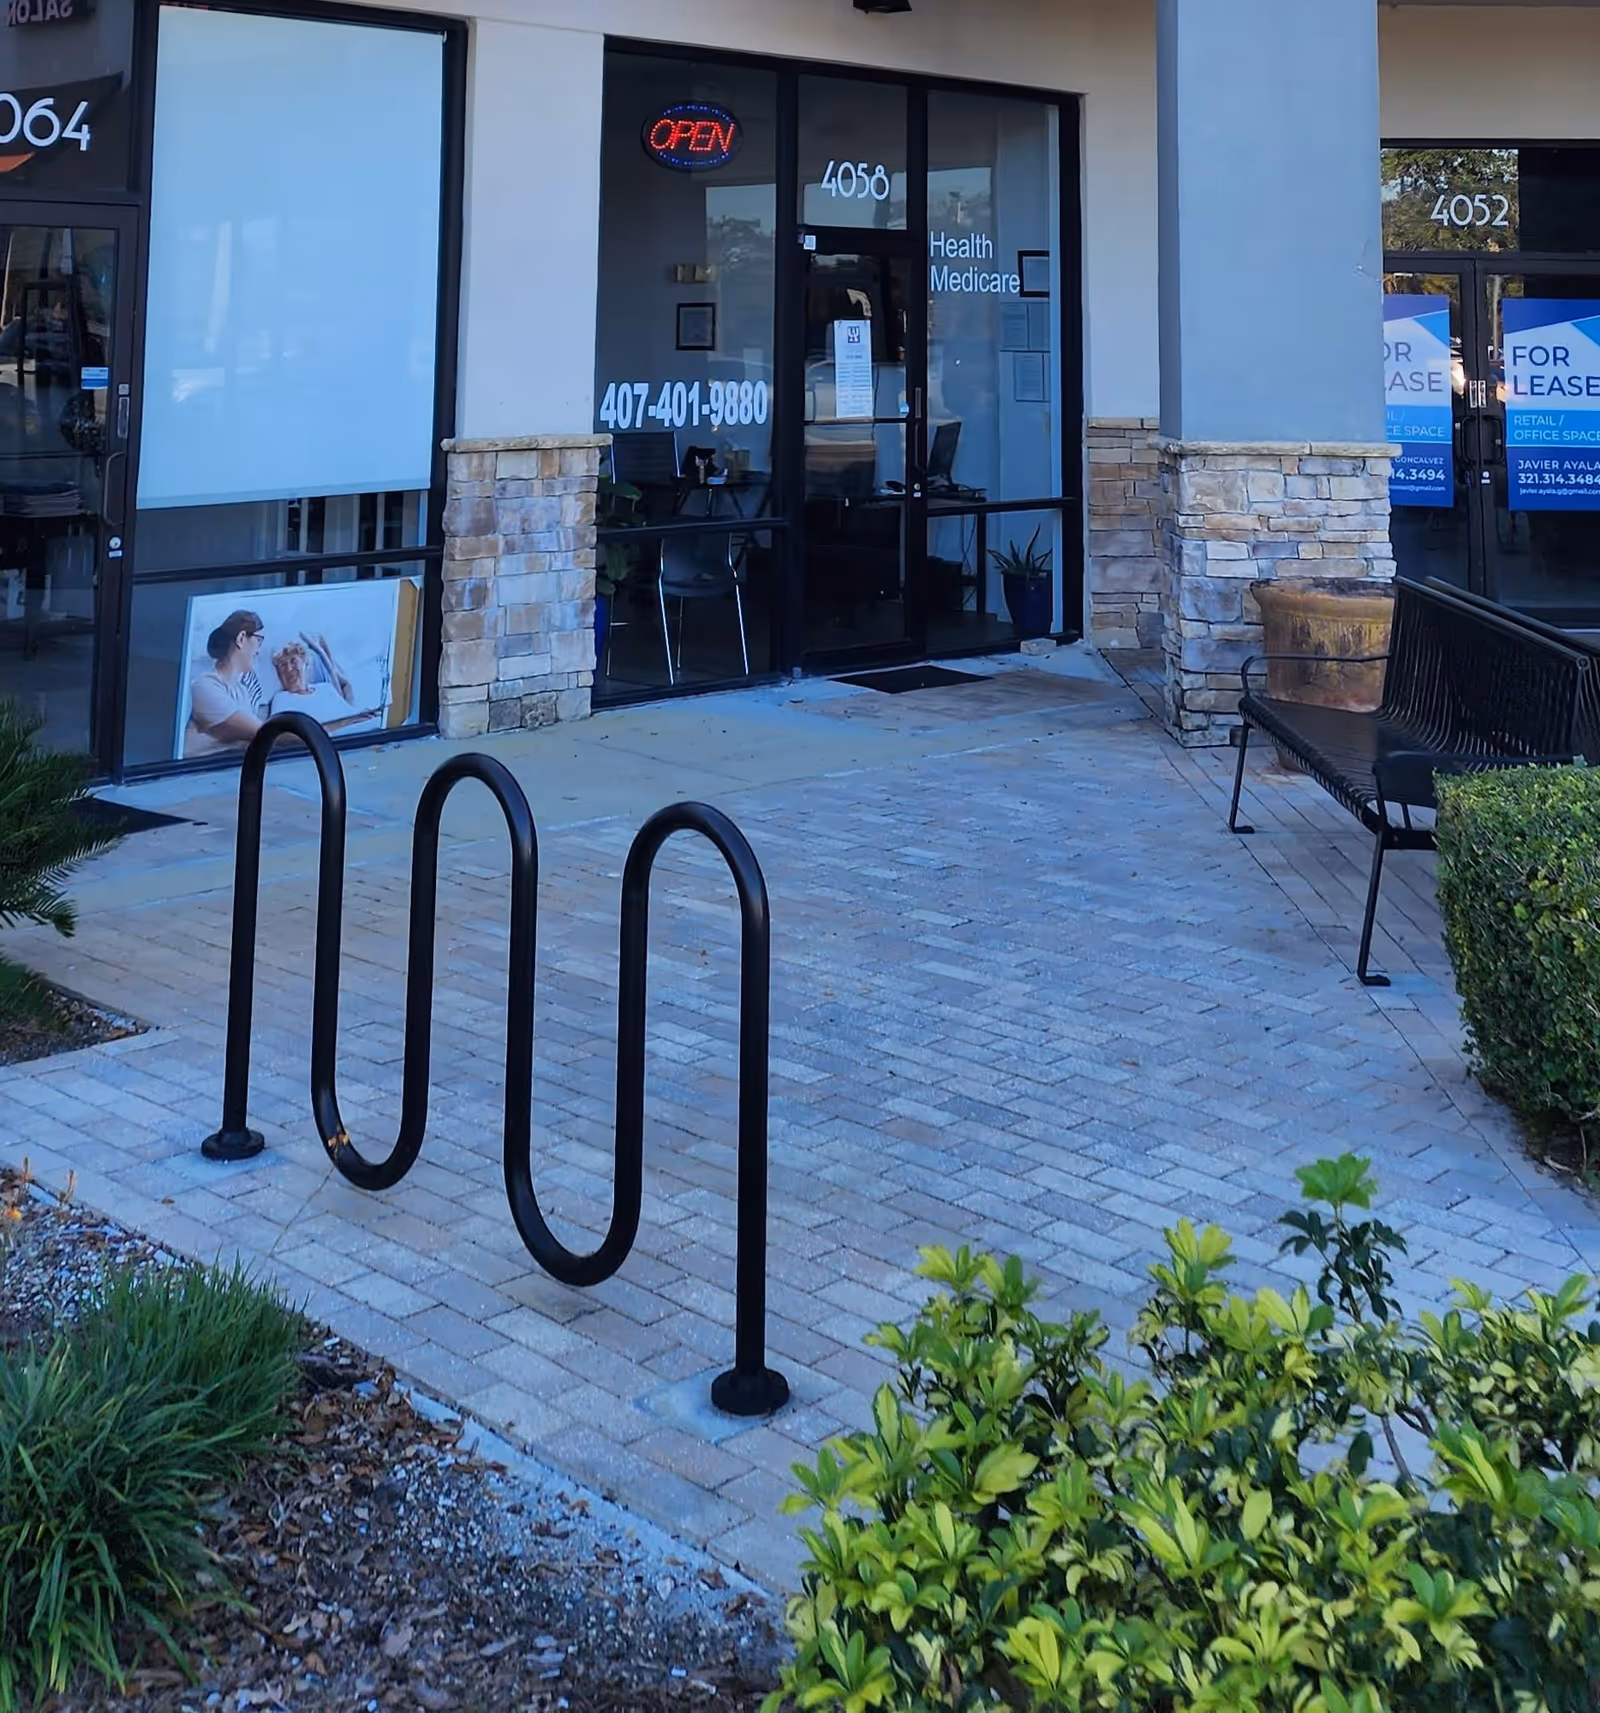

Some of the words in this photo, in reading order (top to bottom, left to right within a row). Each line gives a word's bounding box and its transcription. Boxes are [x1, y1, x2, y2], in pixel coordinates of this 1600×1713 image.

[649, 118, 736, 153] OPEN
[821, 160, 890, 201] 4058
[1430, 194, 1509, 226] 4052
[930, 231, 993, 259] Health
[930, 265, 1021, 294] Medicare
[1512, 345, 1570, 368] FOR
[1385, 370, 1443, 393] ASE
[1513, 374, 1600, 397] LEASE
[599, 379, 768, 430] 407-401-9880
[1404, 425, 1445, 437] SPACE
[1514, 414, 1556, 426] RETAIL
[1514, 429, 1560, 441] OFFICE
[1518, 459, 1560, 470] JAVIER
[1563, 461, 1600, 471] AYALA
[1518, 473, 1600, 485] 321.314.3484
